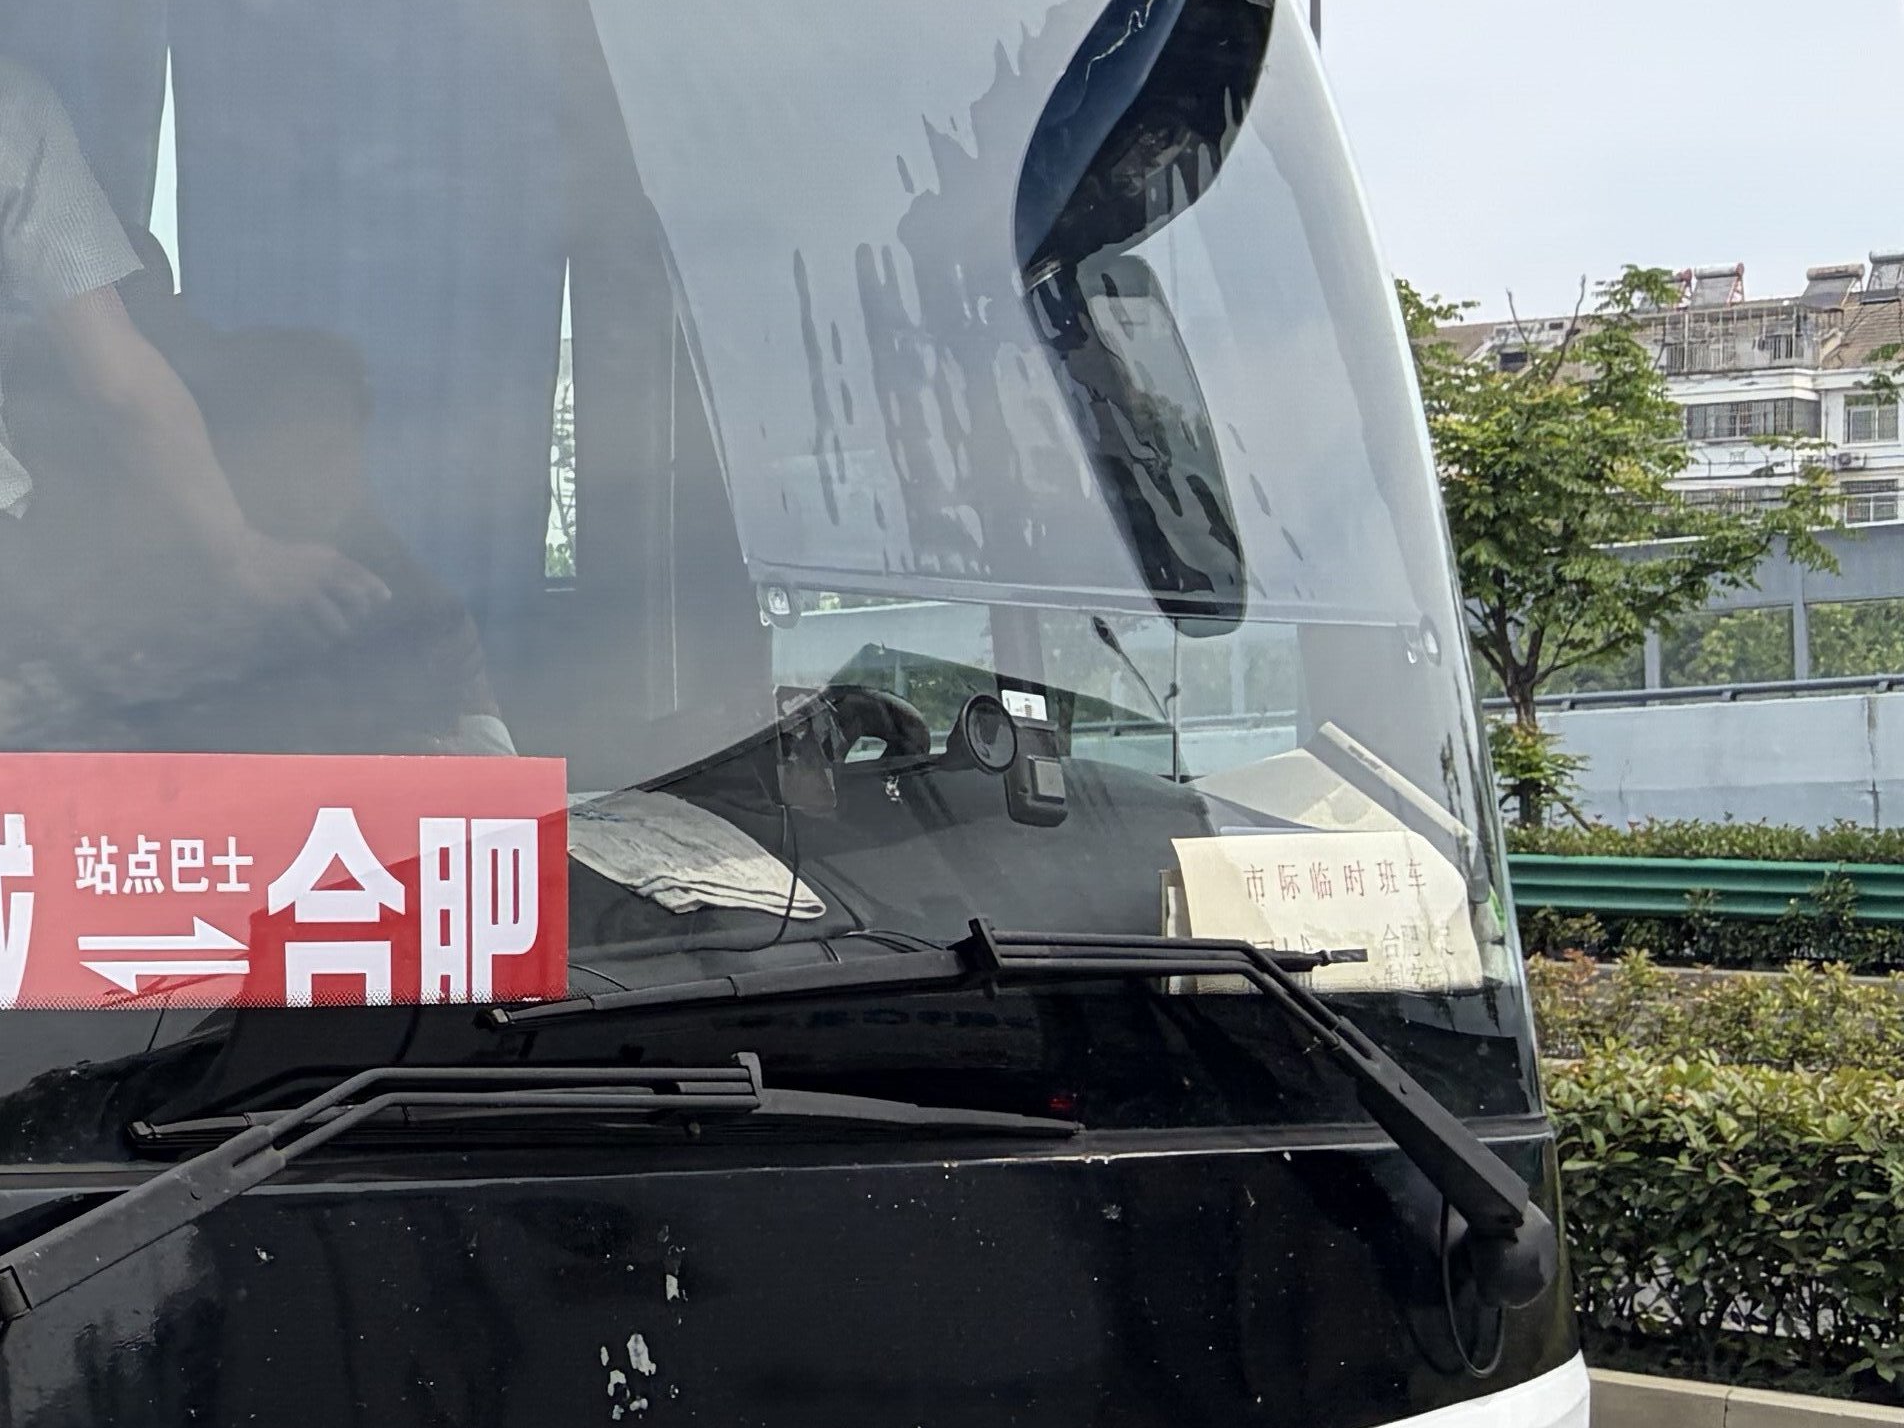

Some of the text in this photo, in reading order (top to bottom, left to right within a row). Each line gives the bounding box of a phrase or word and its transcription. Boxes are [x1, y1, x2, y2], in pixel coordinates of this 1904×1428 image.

[74, 834, 254, 897] 站点巴士
[267, 806, 539, 1008] 合肥
[1243, 857, 1427, 904] 市际临时班车
